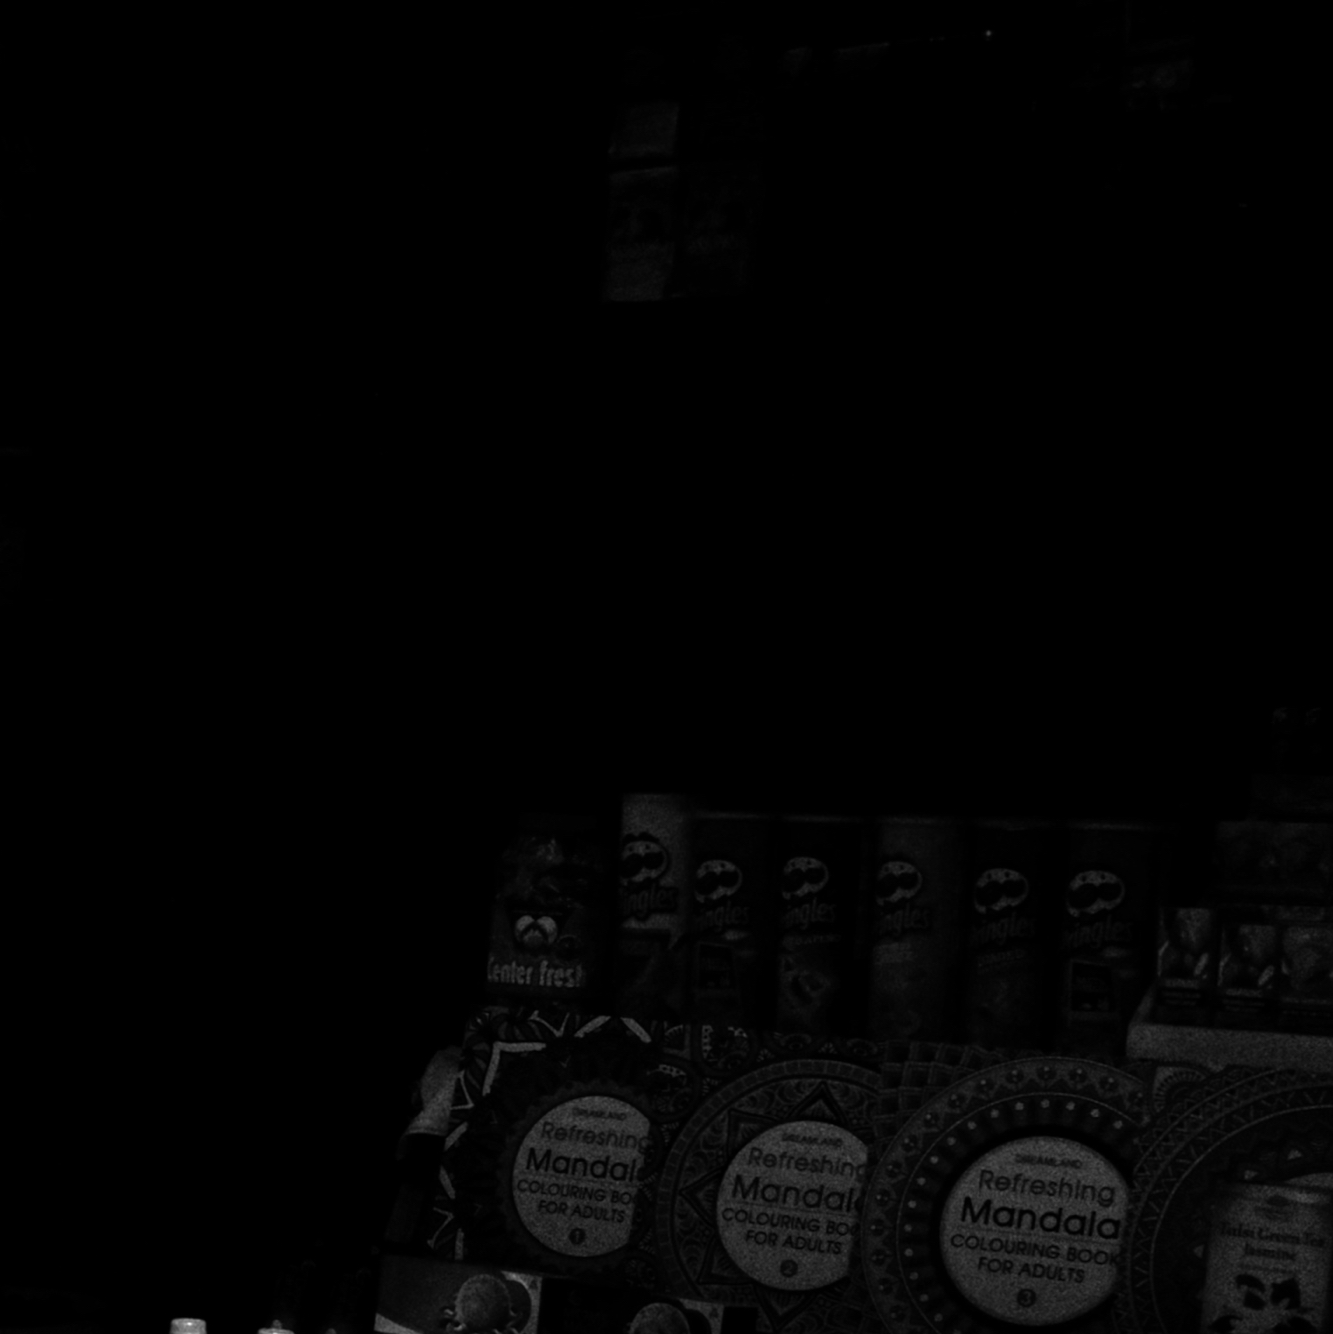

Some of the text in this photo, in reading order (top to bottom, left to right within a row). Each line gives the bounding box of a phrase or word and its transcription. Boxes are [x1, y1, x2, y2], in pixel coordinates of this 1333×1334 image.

[525, 1147, 641, 1184] Mandal
[516, 1179, 607, 1205] COLOURING
[978, 1169, 1117, 1208] Refreshing
[537, 1200, 627, 1225] FOR ADULTS
[721, 1207, 821, 1235] COLOURING
[960, 1196, 1122, 1241] Mandala
[745, 1229, 844, 1256] FOR ADULTS
[950, 1233, 1061, 1261] COLOURING
[977, 1256, 1086, 1285] FOR ADULTS
